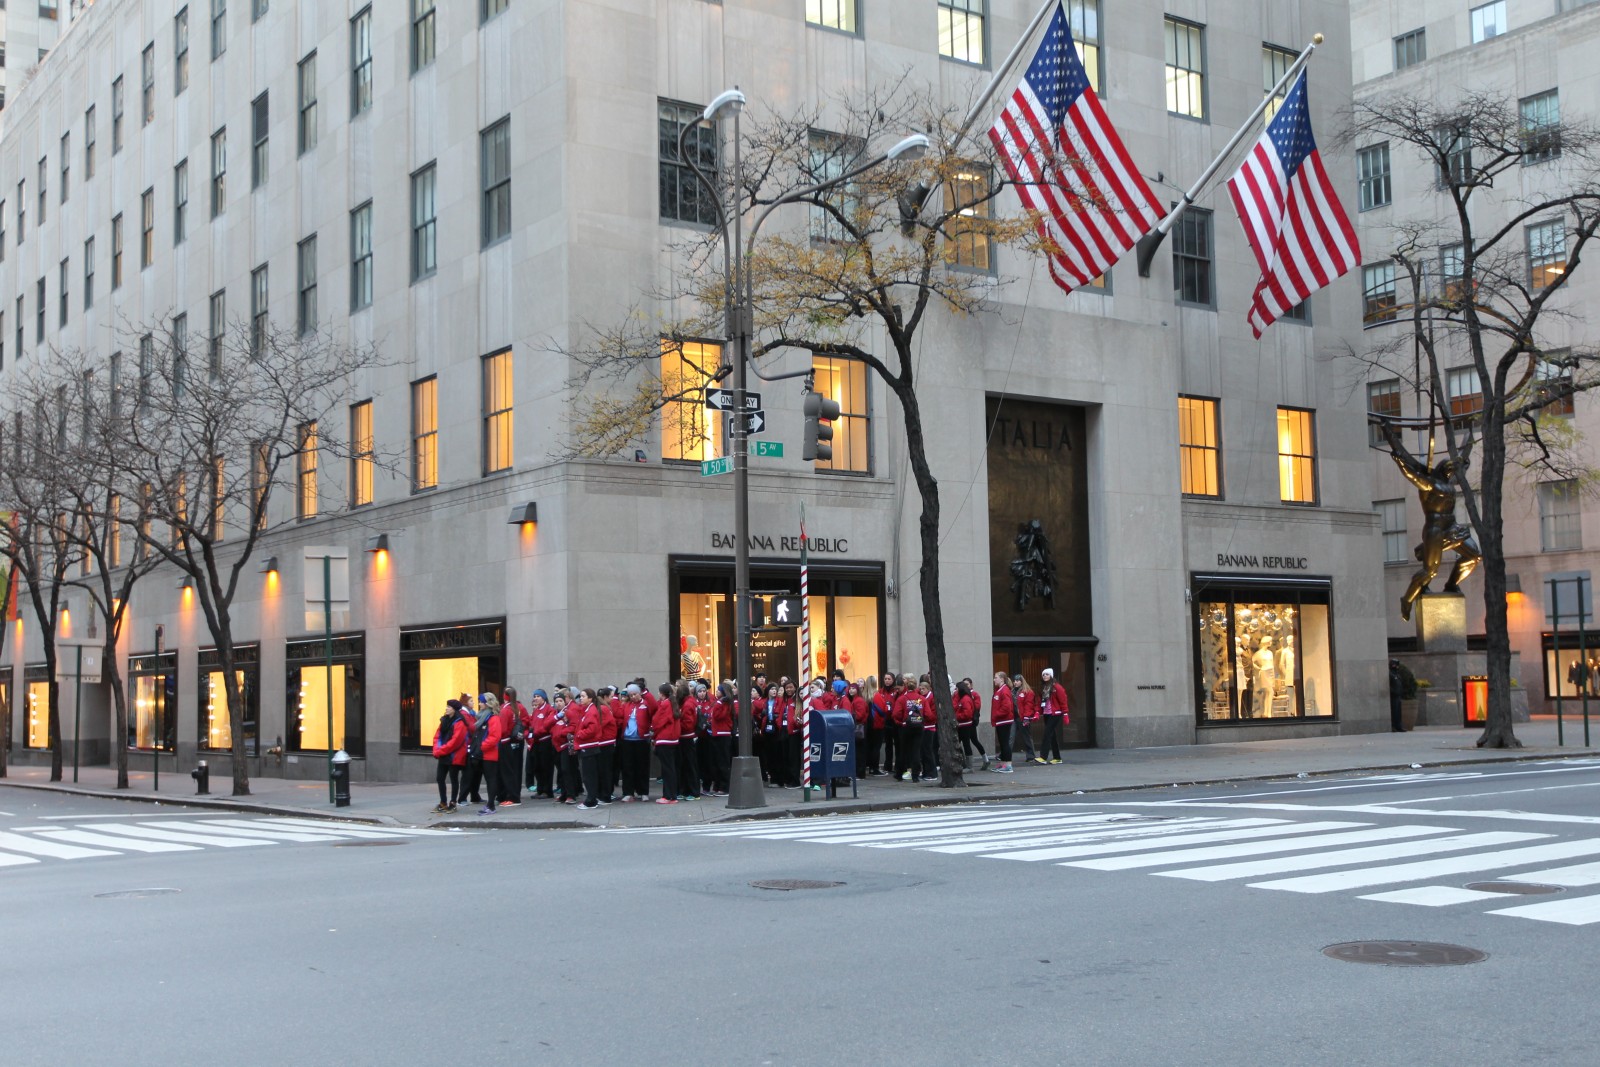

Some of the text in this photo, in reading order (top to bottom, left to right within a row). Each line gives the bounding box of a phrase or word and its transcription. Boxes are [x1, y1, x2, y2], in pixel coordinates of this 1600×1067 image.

[760, 443, 767, 455] 5
[702, 462, 709, 475] W
[711, 460, 721, 473] 50
[712, 533, 848, 553] BANA REUBLIC
[1217, 553, 1308, 570] BANANA REPUBLIC
[754, 640, 773, 648] special
